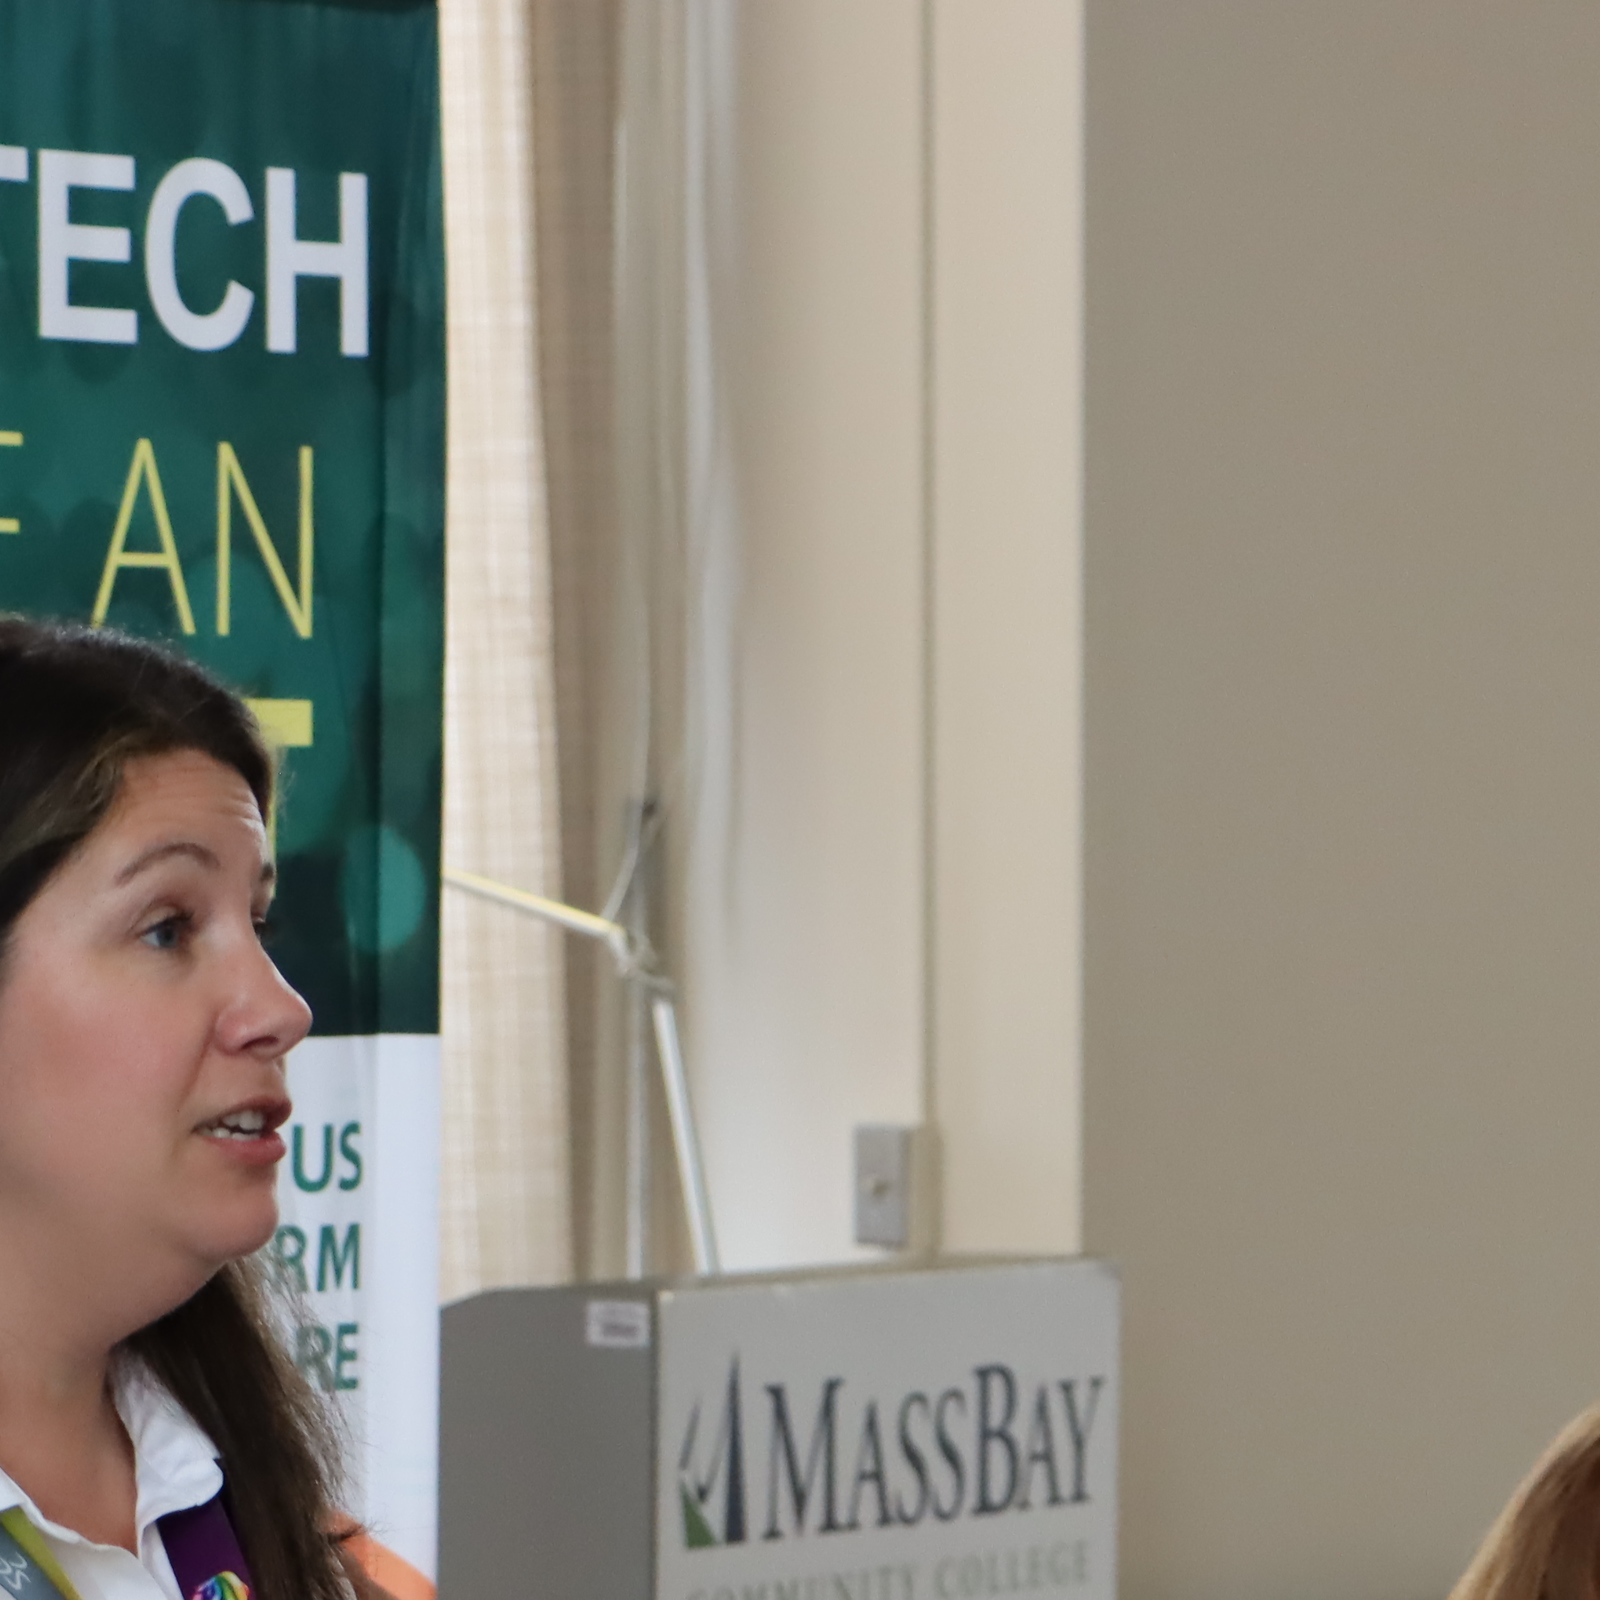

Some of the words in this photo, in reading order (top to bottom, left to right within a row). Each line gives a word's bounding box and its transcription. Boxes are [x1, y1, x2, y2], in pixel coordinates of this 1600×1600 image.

[92, 437, 314, 640] AN
[291, 1121, 363, 1194] US
[934, 1538, 1093, 1600] COLLEGE
